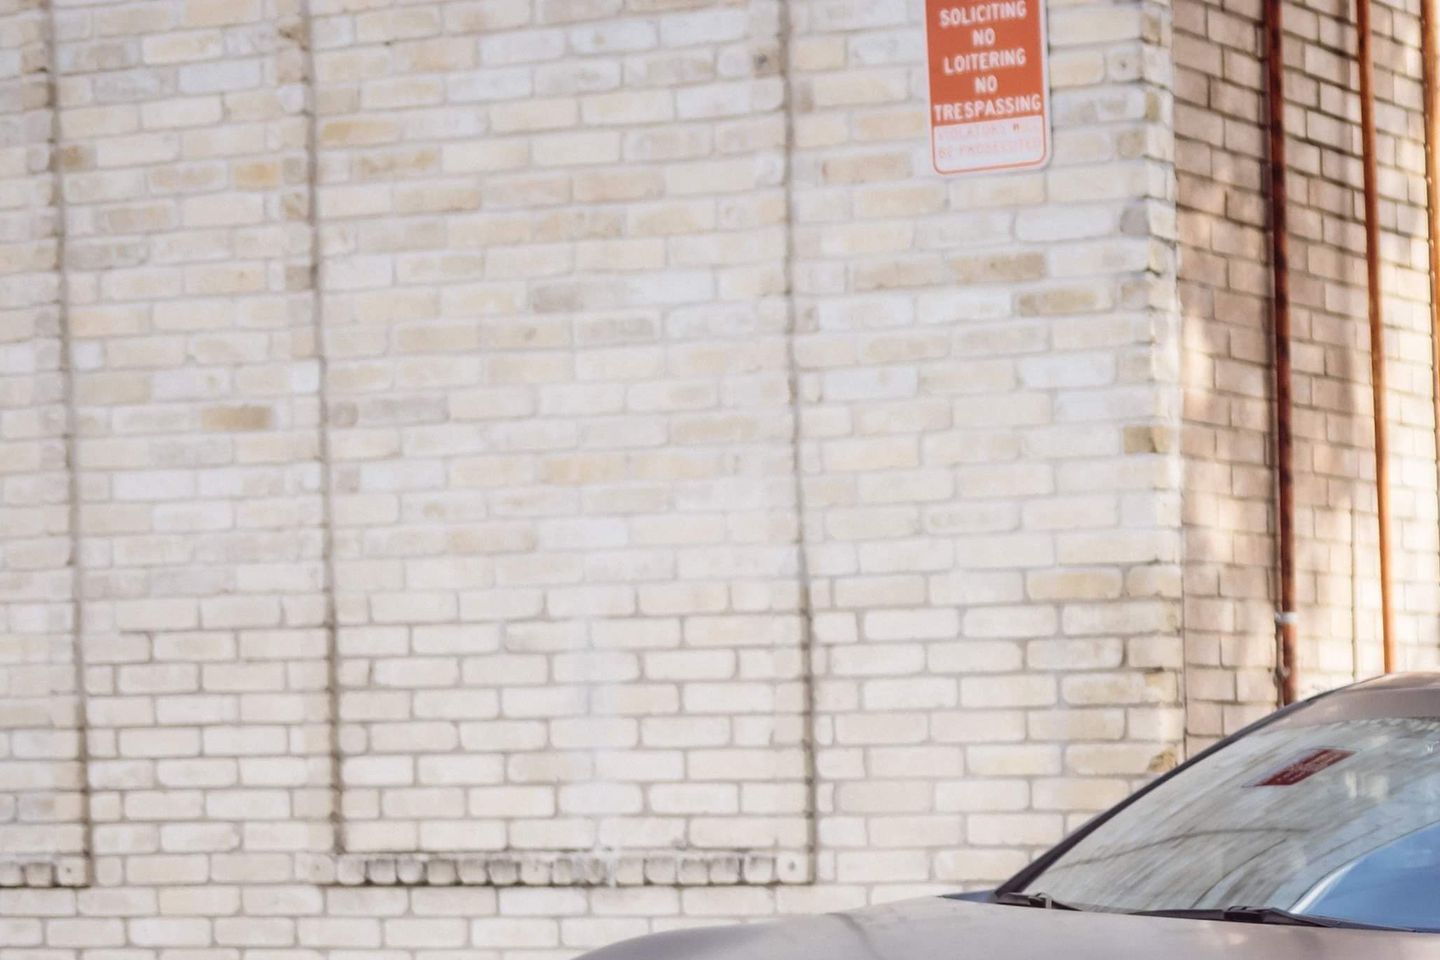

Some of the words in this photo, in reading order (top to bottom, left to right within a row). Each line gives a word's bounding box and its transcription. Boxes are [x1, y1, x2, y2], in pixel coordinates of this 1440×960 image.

[939, 0, 1027, 27] SOLICITING
[972, 27, 996, 46] NO
[943, 48, 1027, 75] LOITERING
[974, 75, 998, 94] NO
[933, 94, 1042, 122] TRESPASSING
